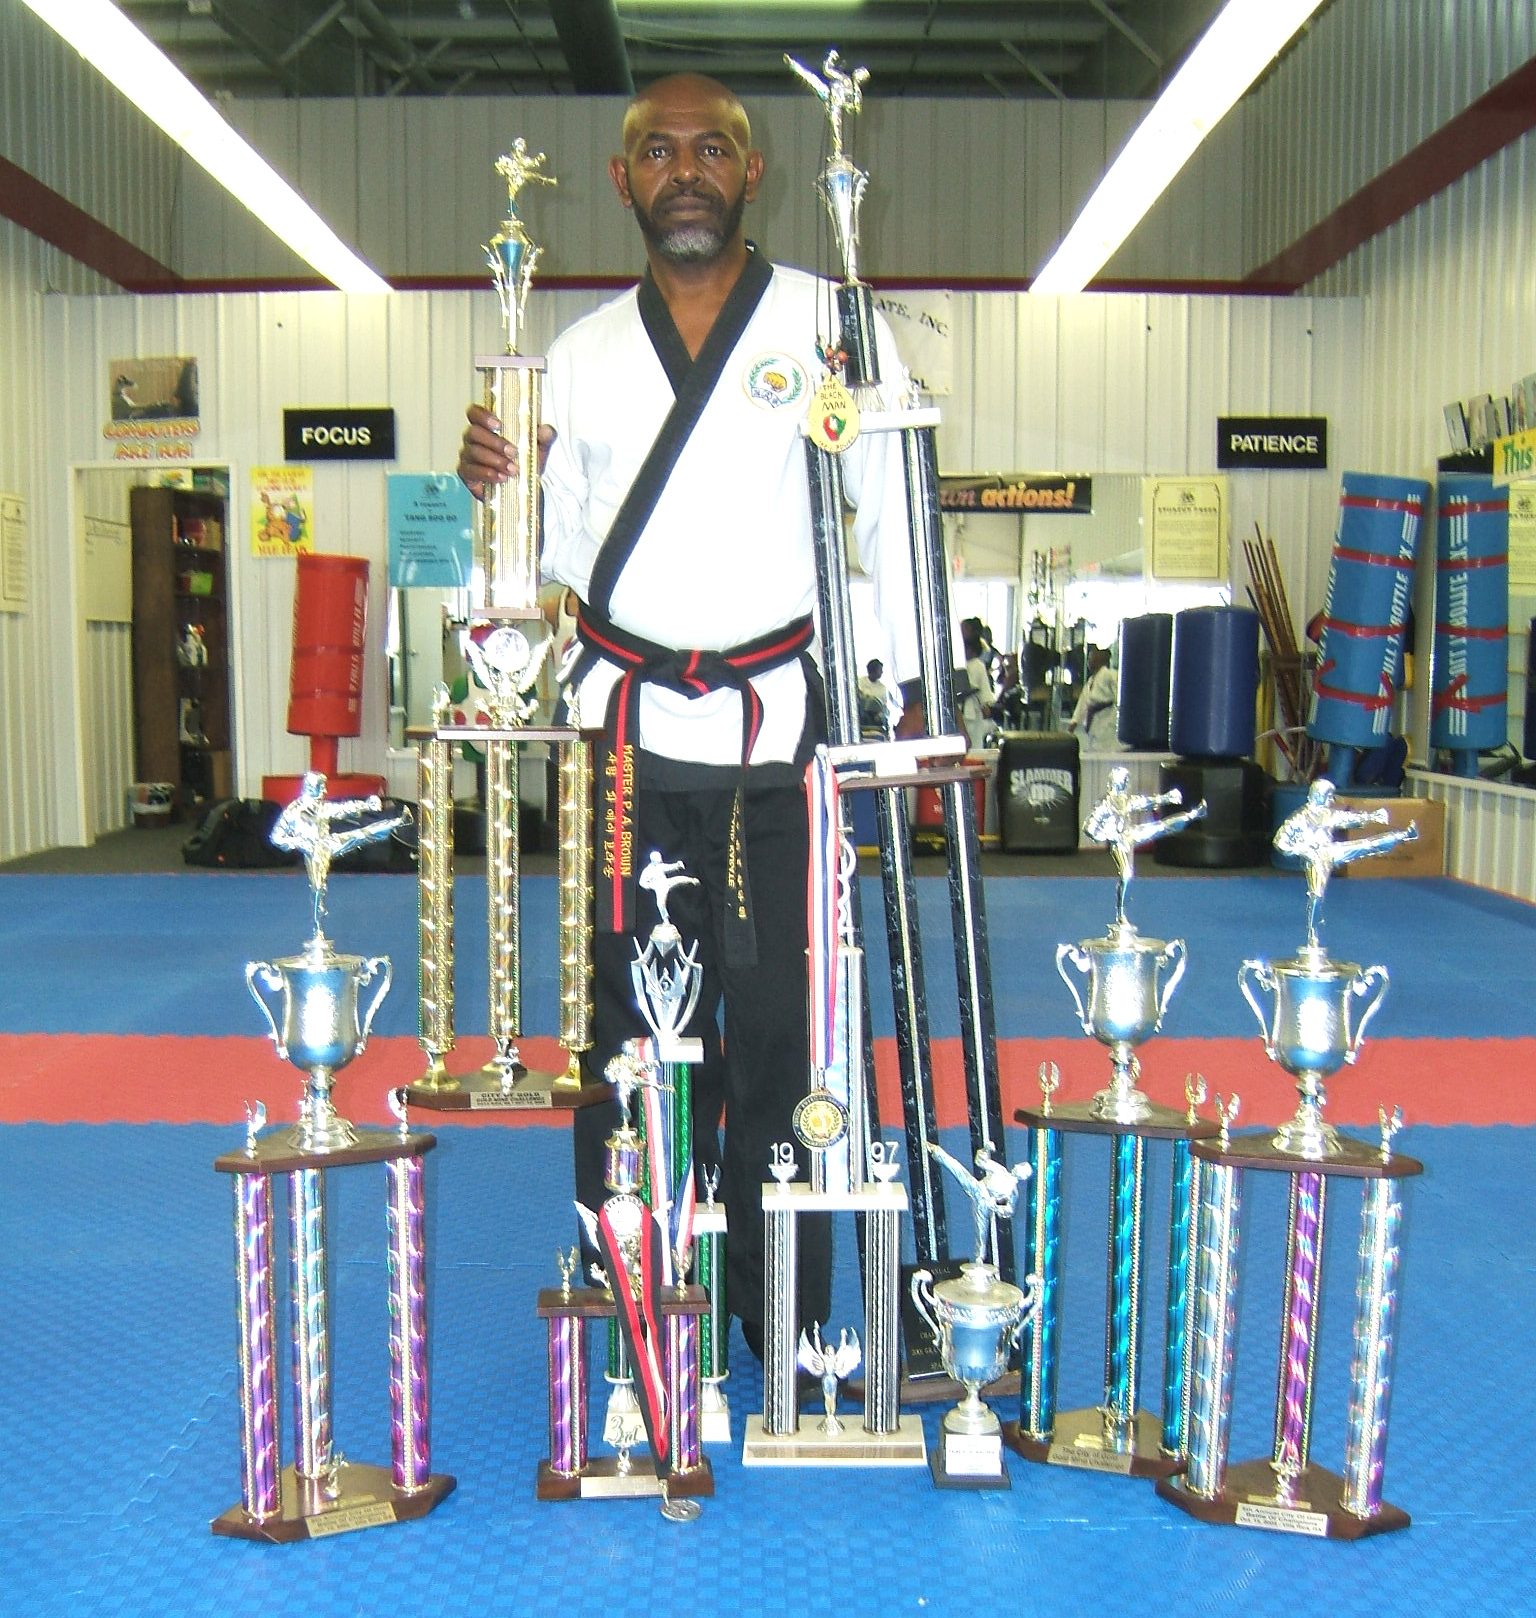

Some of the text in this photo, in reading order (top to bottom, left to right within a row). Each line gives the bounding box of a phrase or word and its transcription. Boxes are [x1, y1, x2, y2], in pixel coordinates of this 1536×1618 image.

[820, 391, 845, 401] BLACK
[822, 383, 837, 391] THE
[822, 401, 846, 412] MAN
[301, 426, 372, 445] FOCUS
[1230, 434, 1319, 454] PATIENCE
[1503, 437, 1532, 475] This
[980, 481, 1076, 508] actions!
[621, 744, 635, 796] MASTER
[620, 831, 633, 878] BROWN
[770, 1141, 794, 1166] 19
[871, 1141, 899, 1166] 97
[607, 1415, 642, 1446] 3rd
